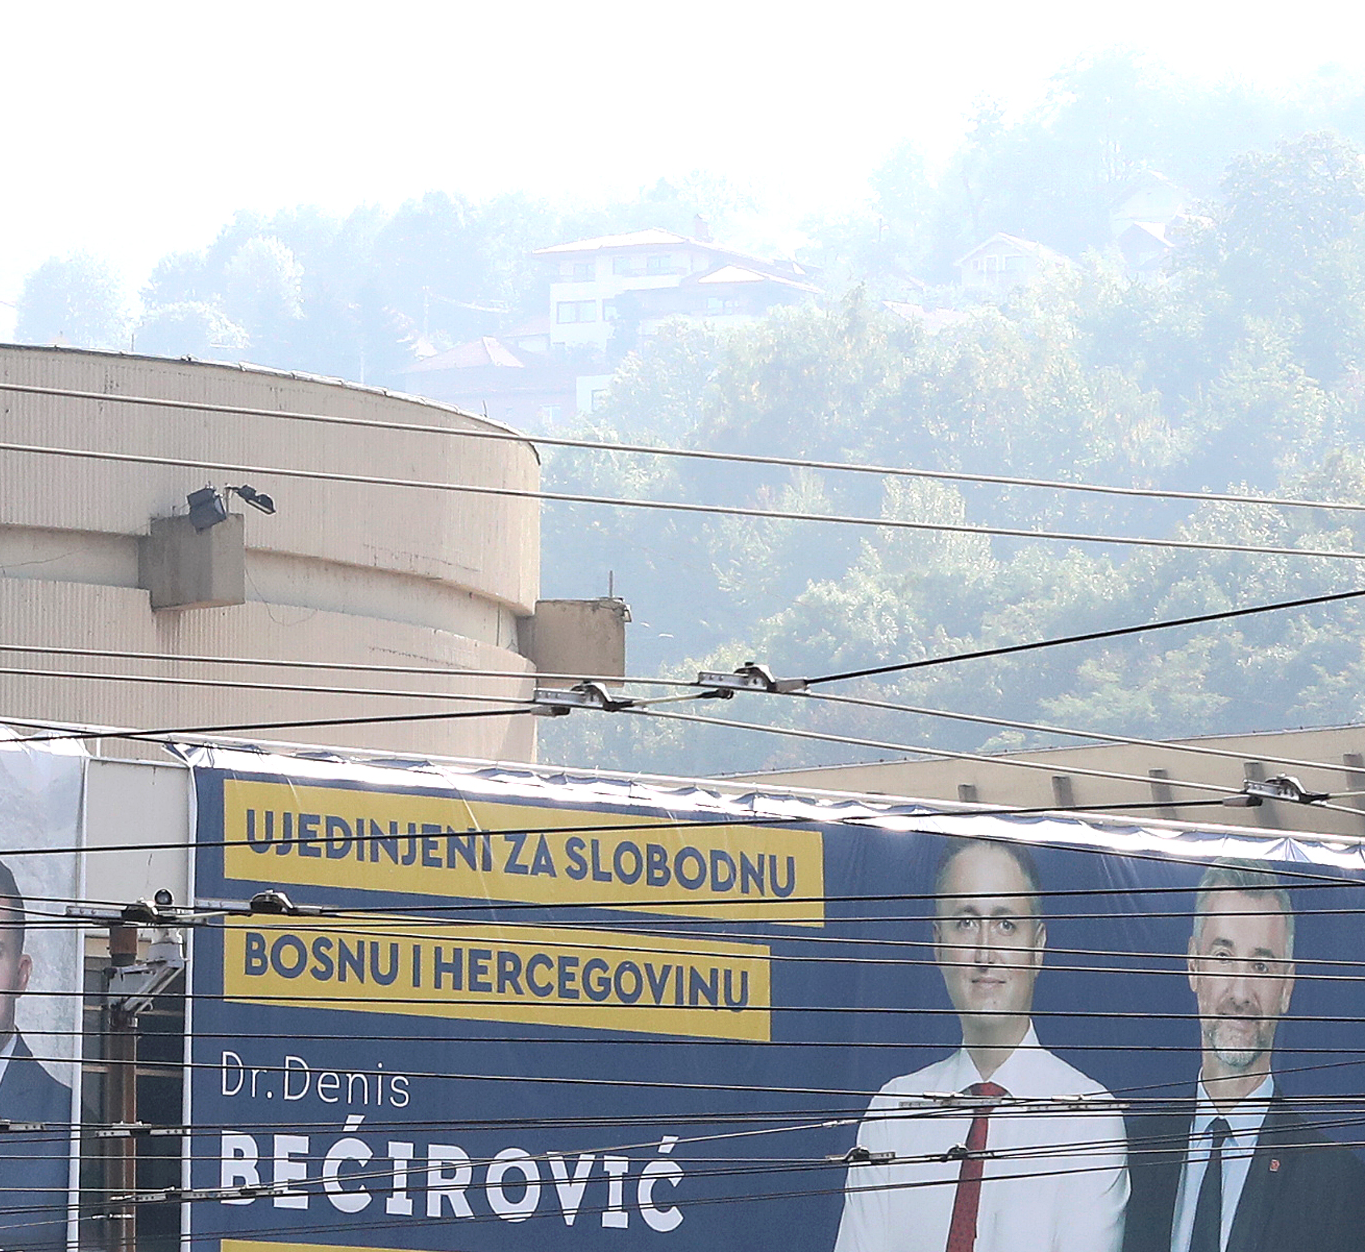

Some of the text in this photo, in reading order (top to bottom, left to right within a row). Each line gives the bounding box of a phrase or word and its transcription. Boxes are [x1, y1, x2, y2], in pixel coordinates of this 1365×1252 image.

[246, 809, 796, 898] UJEDINJENI ZA SLOBODNU
[244, 932, 748, 1013] BOSNU I HERCEGOVINU
[220, 1114, 685, 1233] BEĆIROVIĆ
